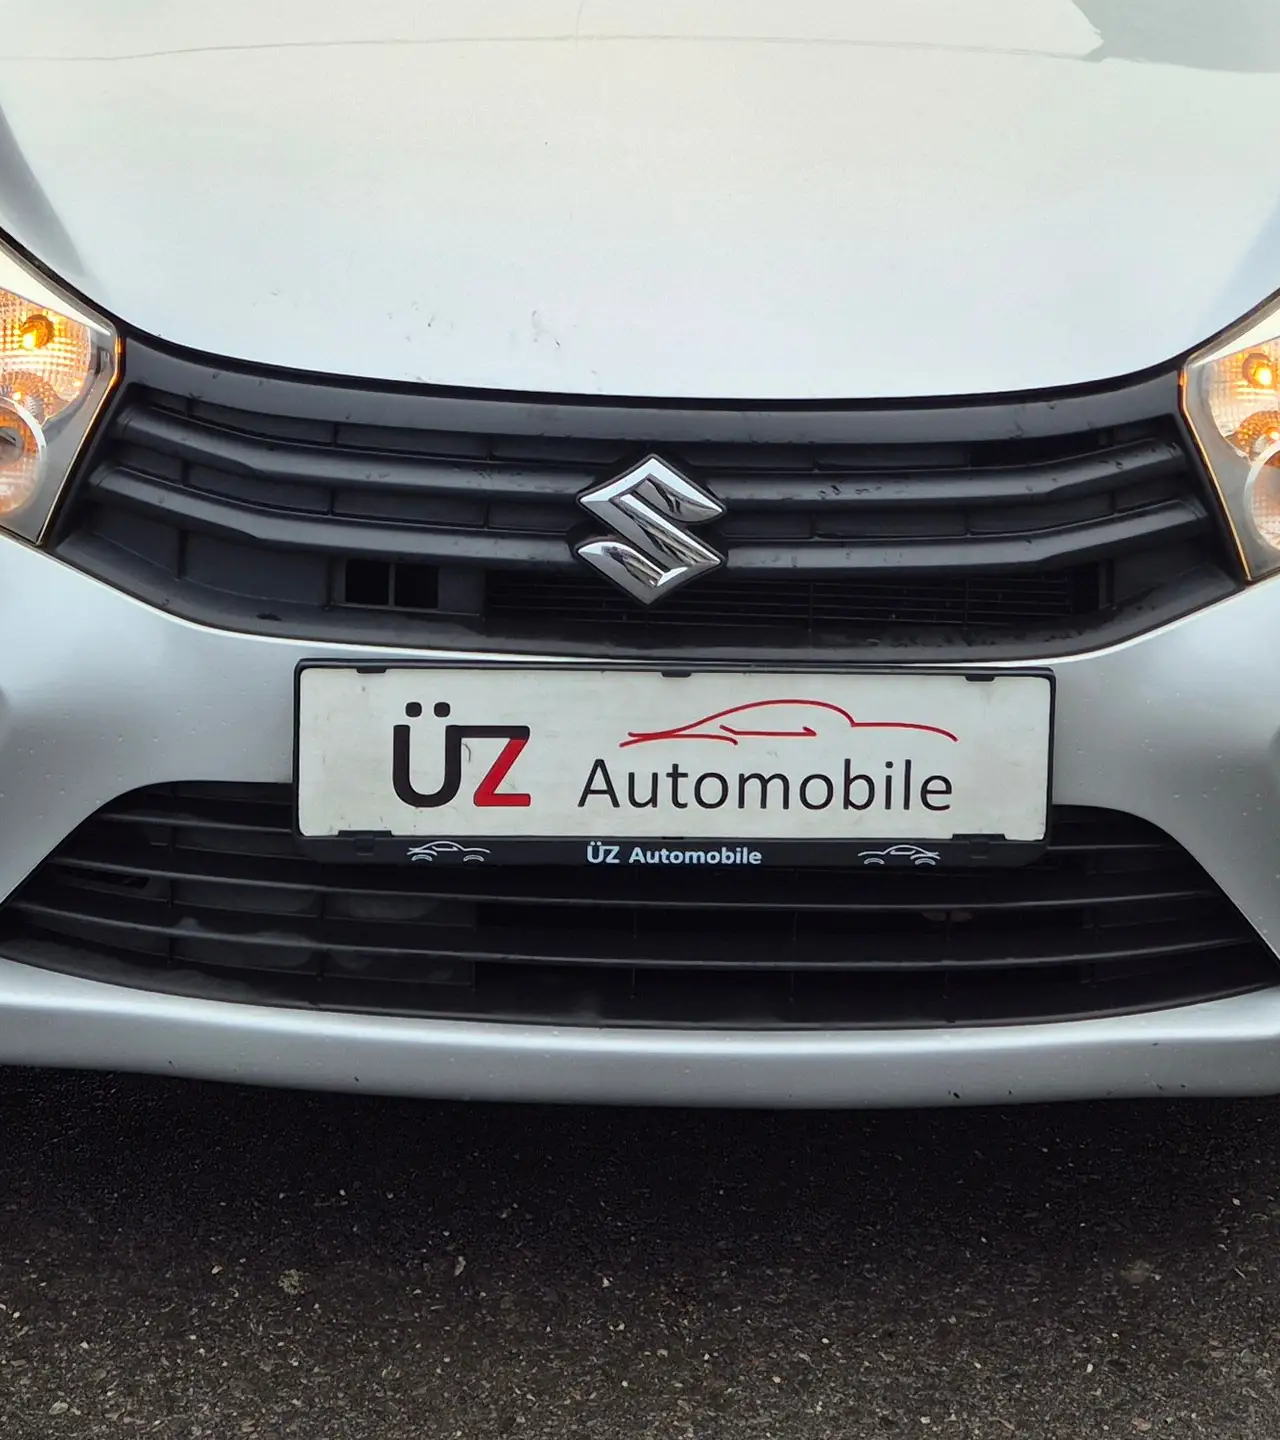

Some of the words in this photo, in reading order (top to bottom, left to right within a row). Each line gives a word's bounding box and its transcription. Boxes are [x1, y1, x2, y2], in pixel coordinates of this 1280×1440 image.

[393, 701, 531, 808] ÜZ
[578, 758, 953, 811] Automobile
[586, 840, 620, 864] ÜZ
[629, 847, 762, 865] Automobile
